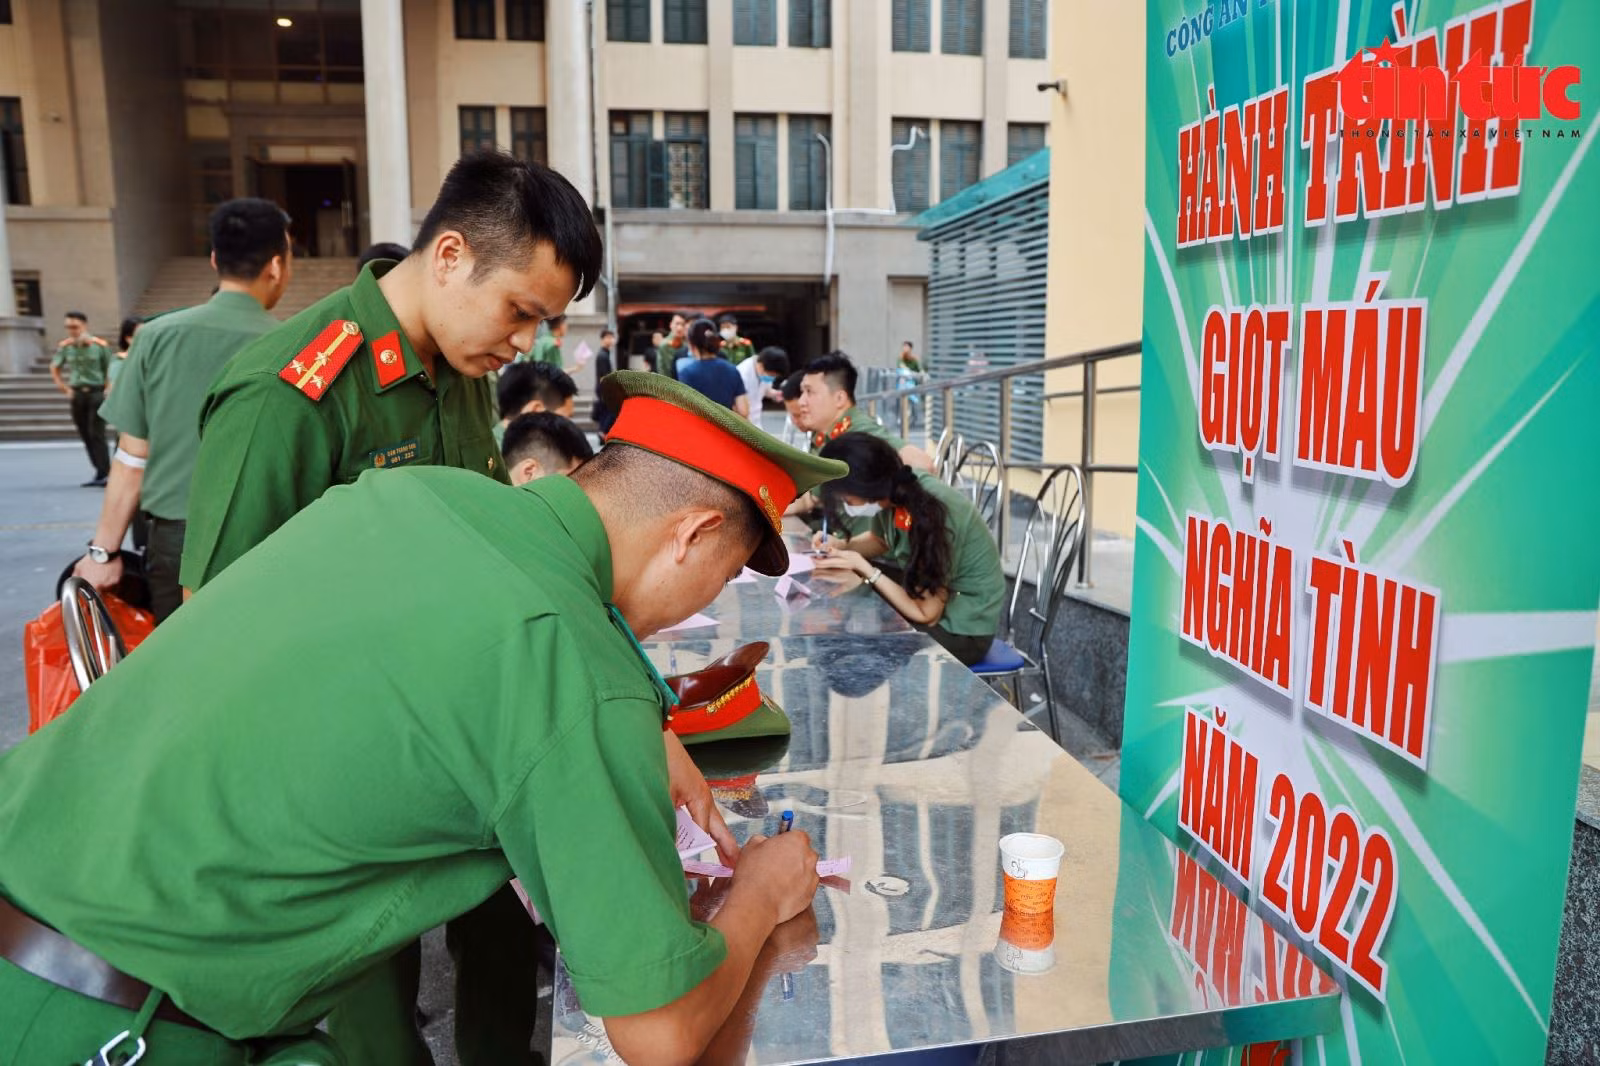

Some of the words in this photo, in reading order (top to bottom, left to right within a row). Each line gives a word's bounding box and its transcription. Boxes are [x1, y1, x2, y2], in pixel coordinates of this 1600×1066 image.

[1166, 5, 1215, 57] CÔNG
[1177, 85, 1290, 246] HÀNH
[1301, 0, 1533, 225] TRÌNH
[1200, 308, 1290, 478] GIỌT
[1297, 279, 1423, 481] MÁU
[1182, 515, 1293, 691] NGHĨA
[1308, 538, 1437, 761] TÌNH
[1180, 705, 1260, 883] NĂM
[1262, 773, 1395, 994] 2022
